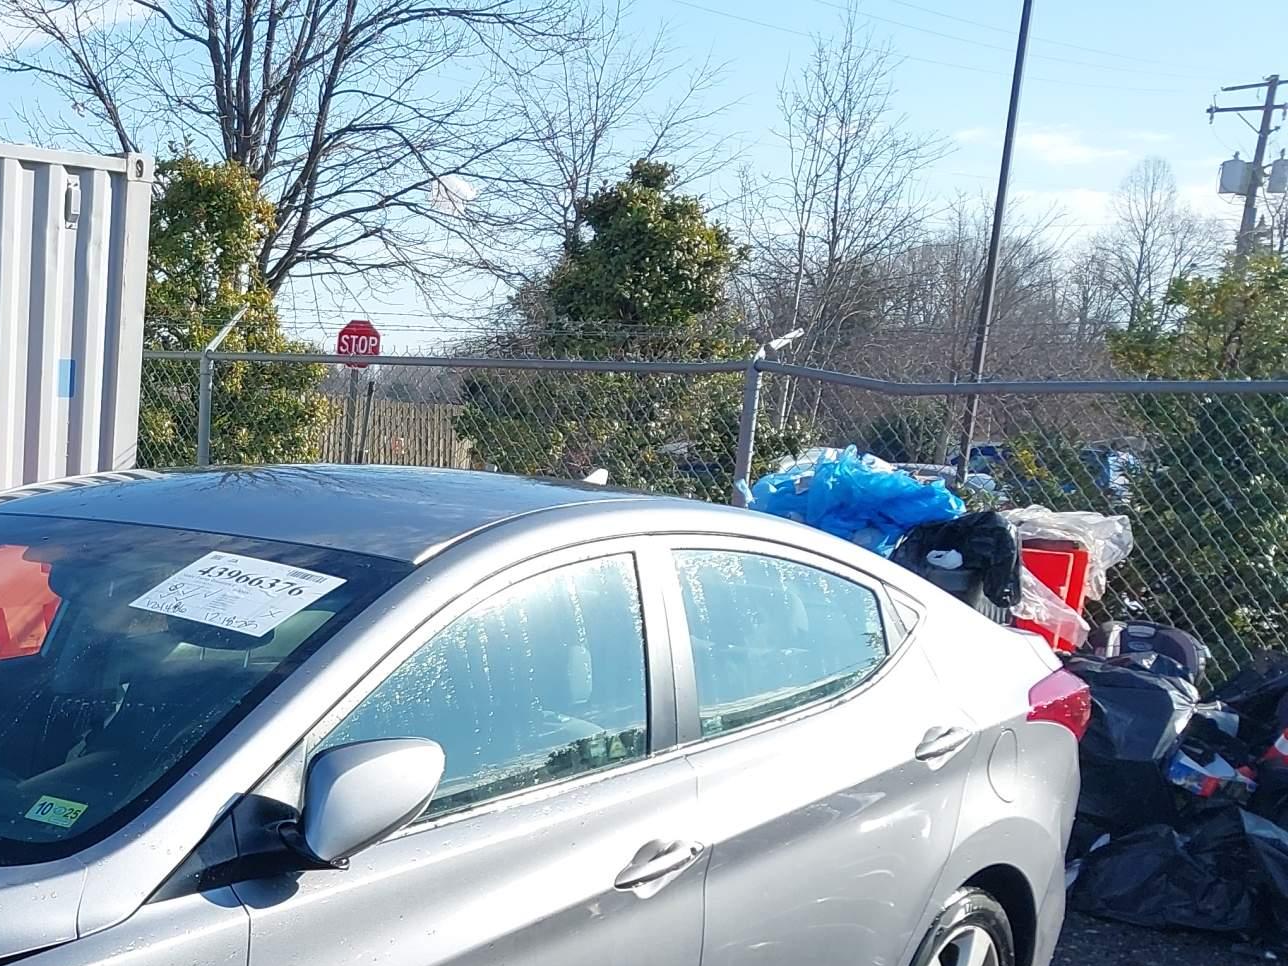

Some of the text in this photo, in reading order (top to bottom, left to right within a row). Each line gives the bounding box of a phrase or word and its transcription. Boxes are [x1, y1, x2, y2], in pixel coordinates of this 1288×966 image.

[339, 334, 378, 354] STOP
[197, 565, 310, 597] 43966376
[35, 801, 82, 820] 10 25
